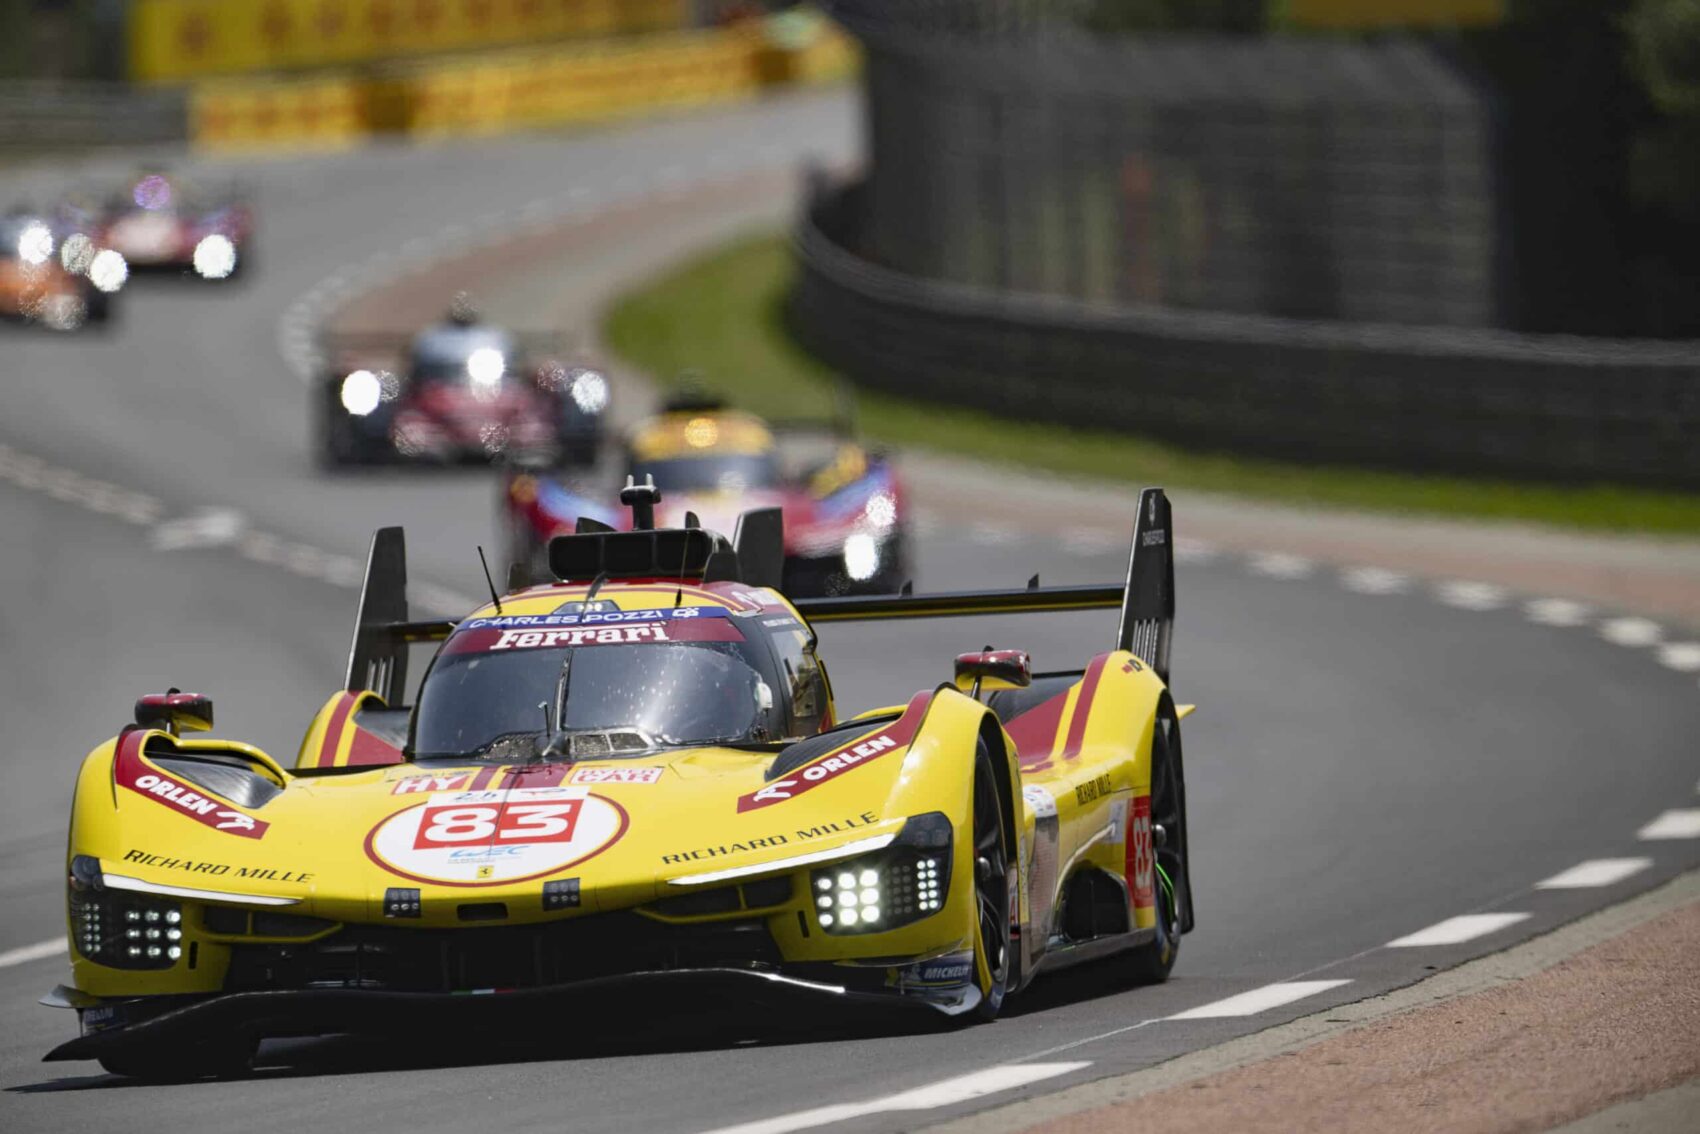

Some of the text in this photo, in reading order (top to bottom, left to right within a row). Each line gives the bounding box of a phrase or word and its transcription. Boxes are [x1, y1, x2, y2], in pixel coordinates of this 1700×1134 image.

[470, 615, 580, 628] CHARLES
[582, 610, 663, 622] POZZI
[490, 622, 669, 650] Ferrari
[803, 735, 896, 781] ORLEN
[135, 775, 218, 815] ORLEN
[424, 804, 572, 843] 83
[662, 811, 880, 864] RICHARD MILLE
[123, 849, 315, 883] RICHARD MILLE
